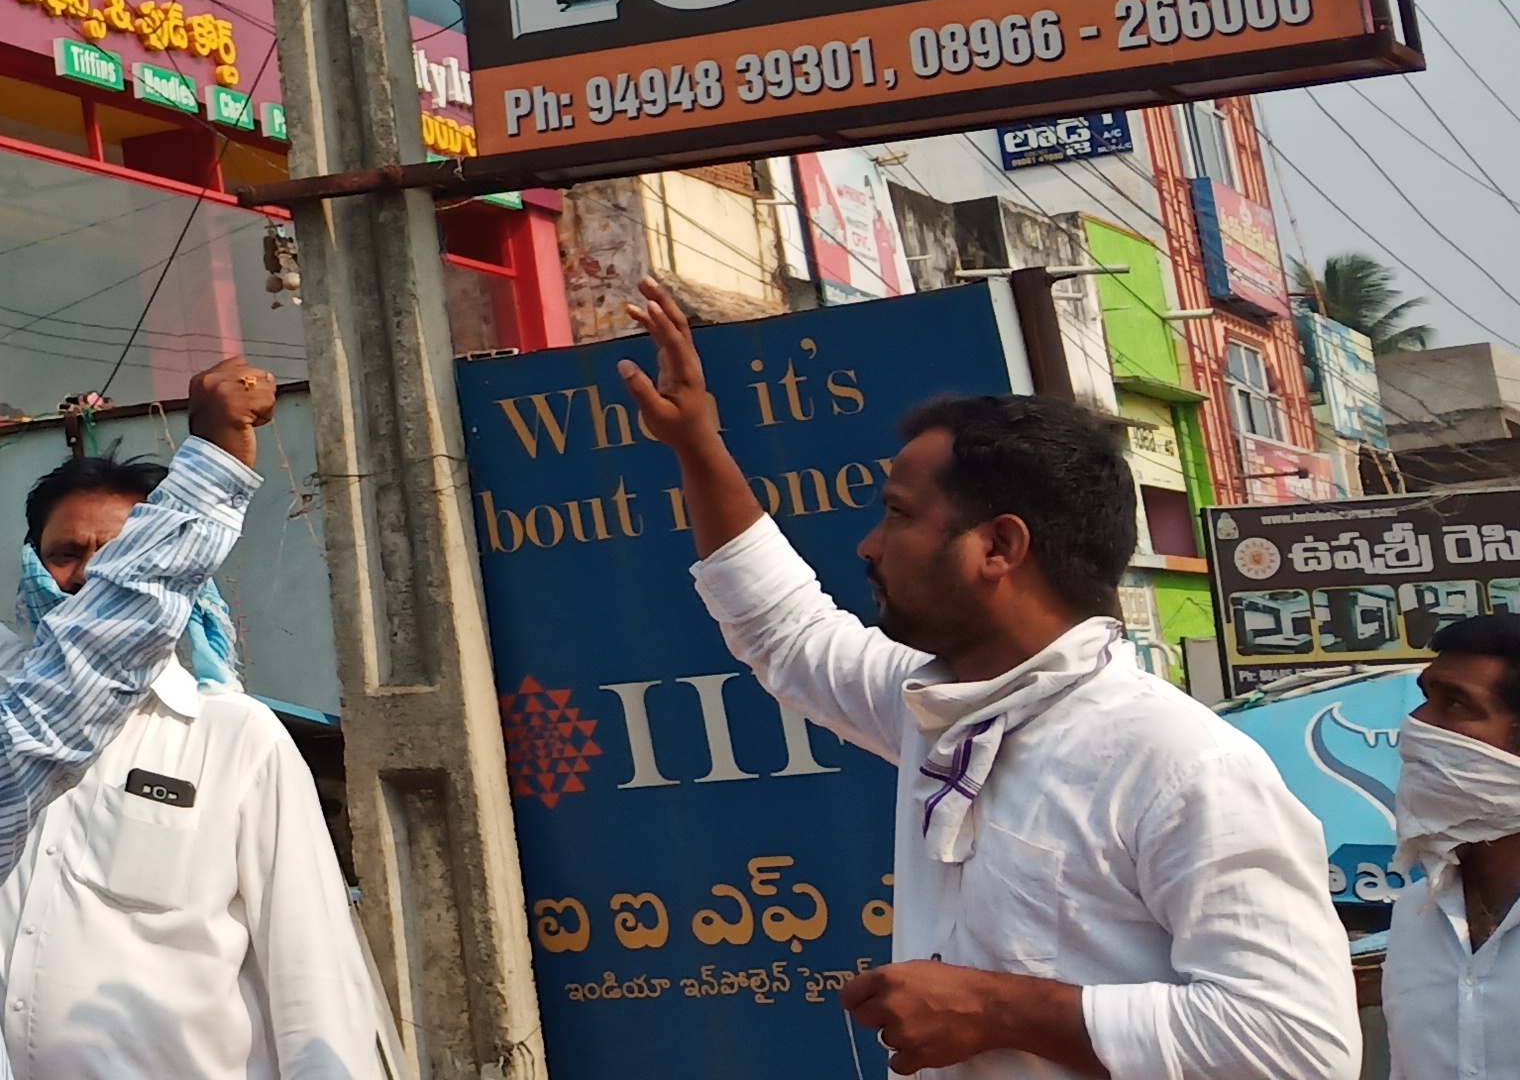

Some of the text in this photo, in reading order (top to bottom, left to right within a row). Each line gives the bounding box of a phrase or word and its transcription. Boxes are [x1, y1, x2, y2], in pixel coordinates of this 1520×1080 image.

[70, 46, 117, 84] Tiffins
[144, 68, 197, 108] Noodles
[505, 84, 574, 139] Ph:
[584, 59, 723, 124] 94948
[734, 34, 898, 102] 39301,
[907, 7, 1063, 80] 08966
[747, 338, 865, 427] it's
[478, 475, 644, 554] bout
[1288, 522, 1435, 575] ఉషశ్రీ
[533, 896, 591, 953] ఐ
[610, 891, 670, 950] ఐ
[691, 855, 829, 953] ఎఫ్
[564, 970, 671, 1003] ఇండియా
